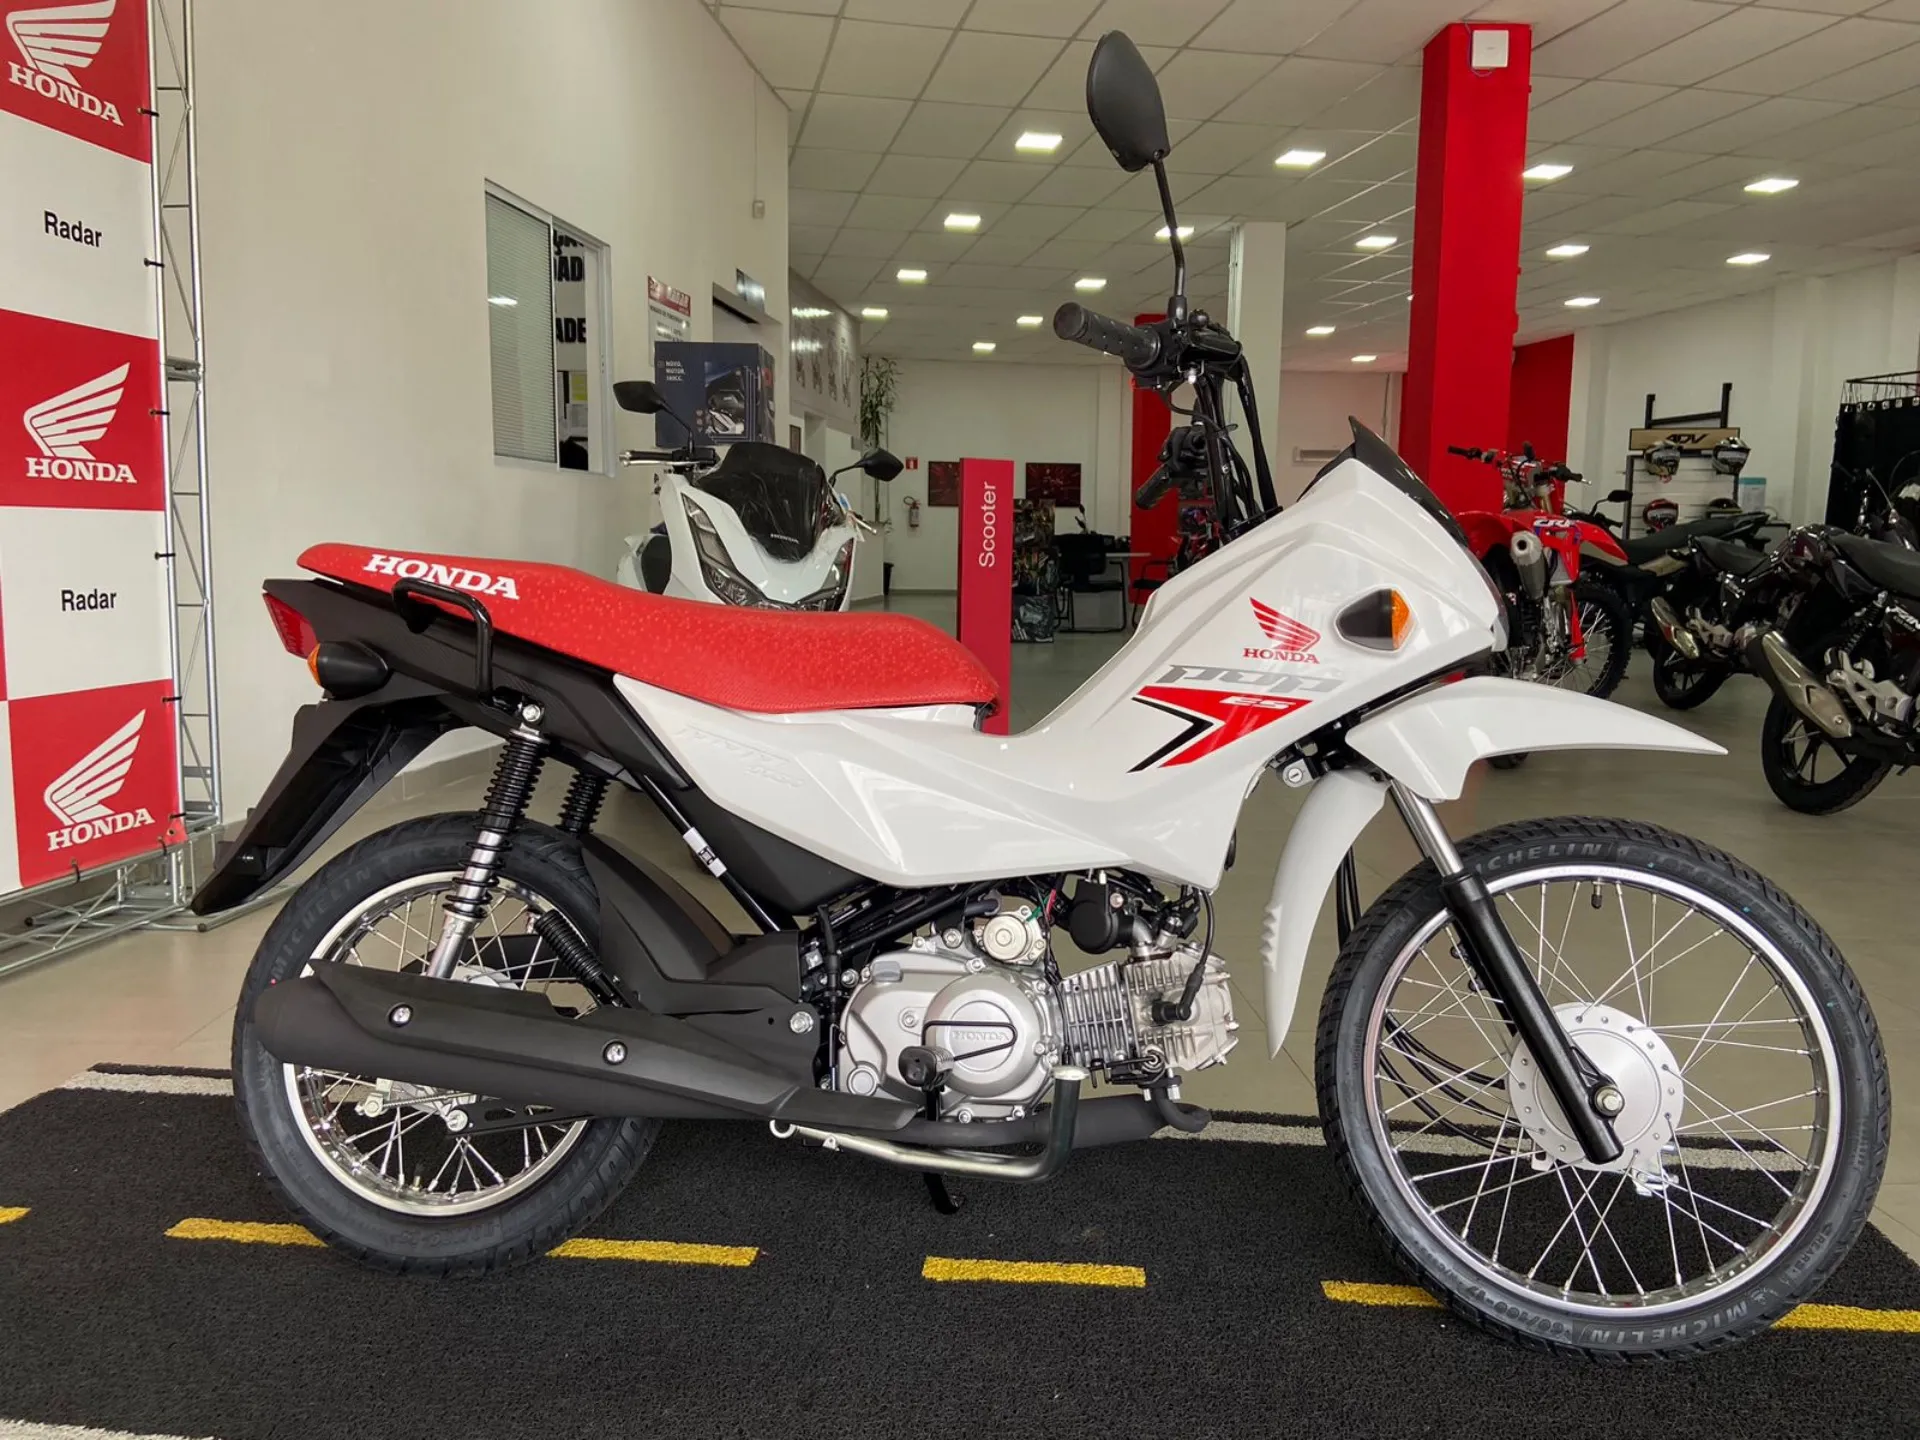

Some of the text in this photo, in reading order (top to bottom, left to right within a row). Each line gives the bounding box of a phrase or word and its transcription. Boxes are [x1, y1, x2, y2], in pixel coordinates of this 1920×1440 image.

[8, 61, 124, 126] HONDA
[44, 210, 102, 247] Radar
[1665, 433, 1709, 444] ADV
[25, 456, 137, 484] HONDA
[979, 481, 997, 567] Scooter
[363, 553, 520, 600] HONDA
[61, 588, 117, 611] Radar
[1243, 647, 1321, 664] HONDA
[47, 808, 155, 851] HONDA
[952, 1030, 1010, 1041] HONDA
[1590, 1302, 1749, 1343] MICHELIN
